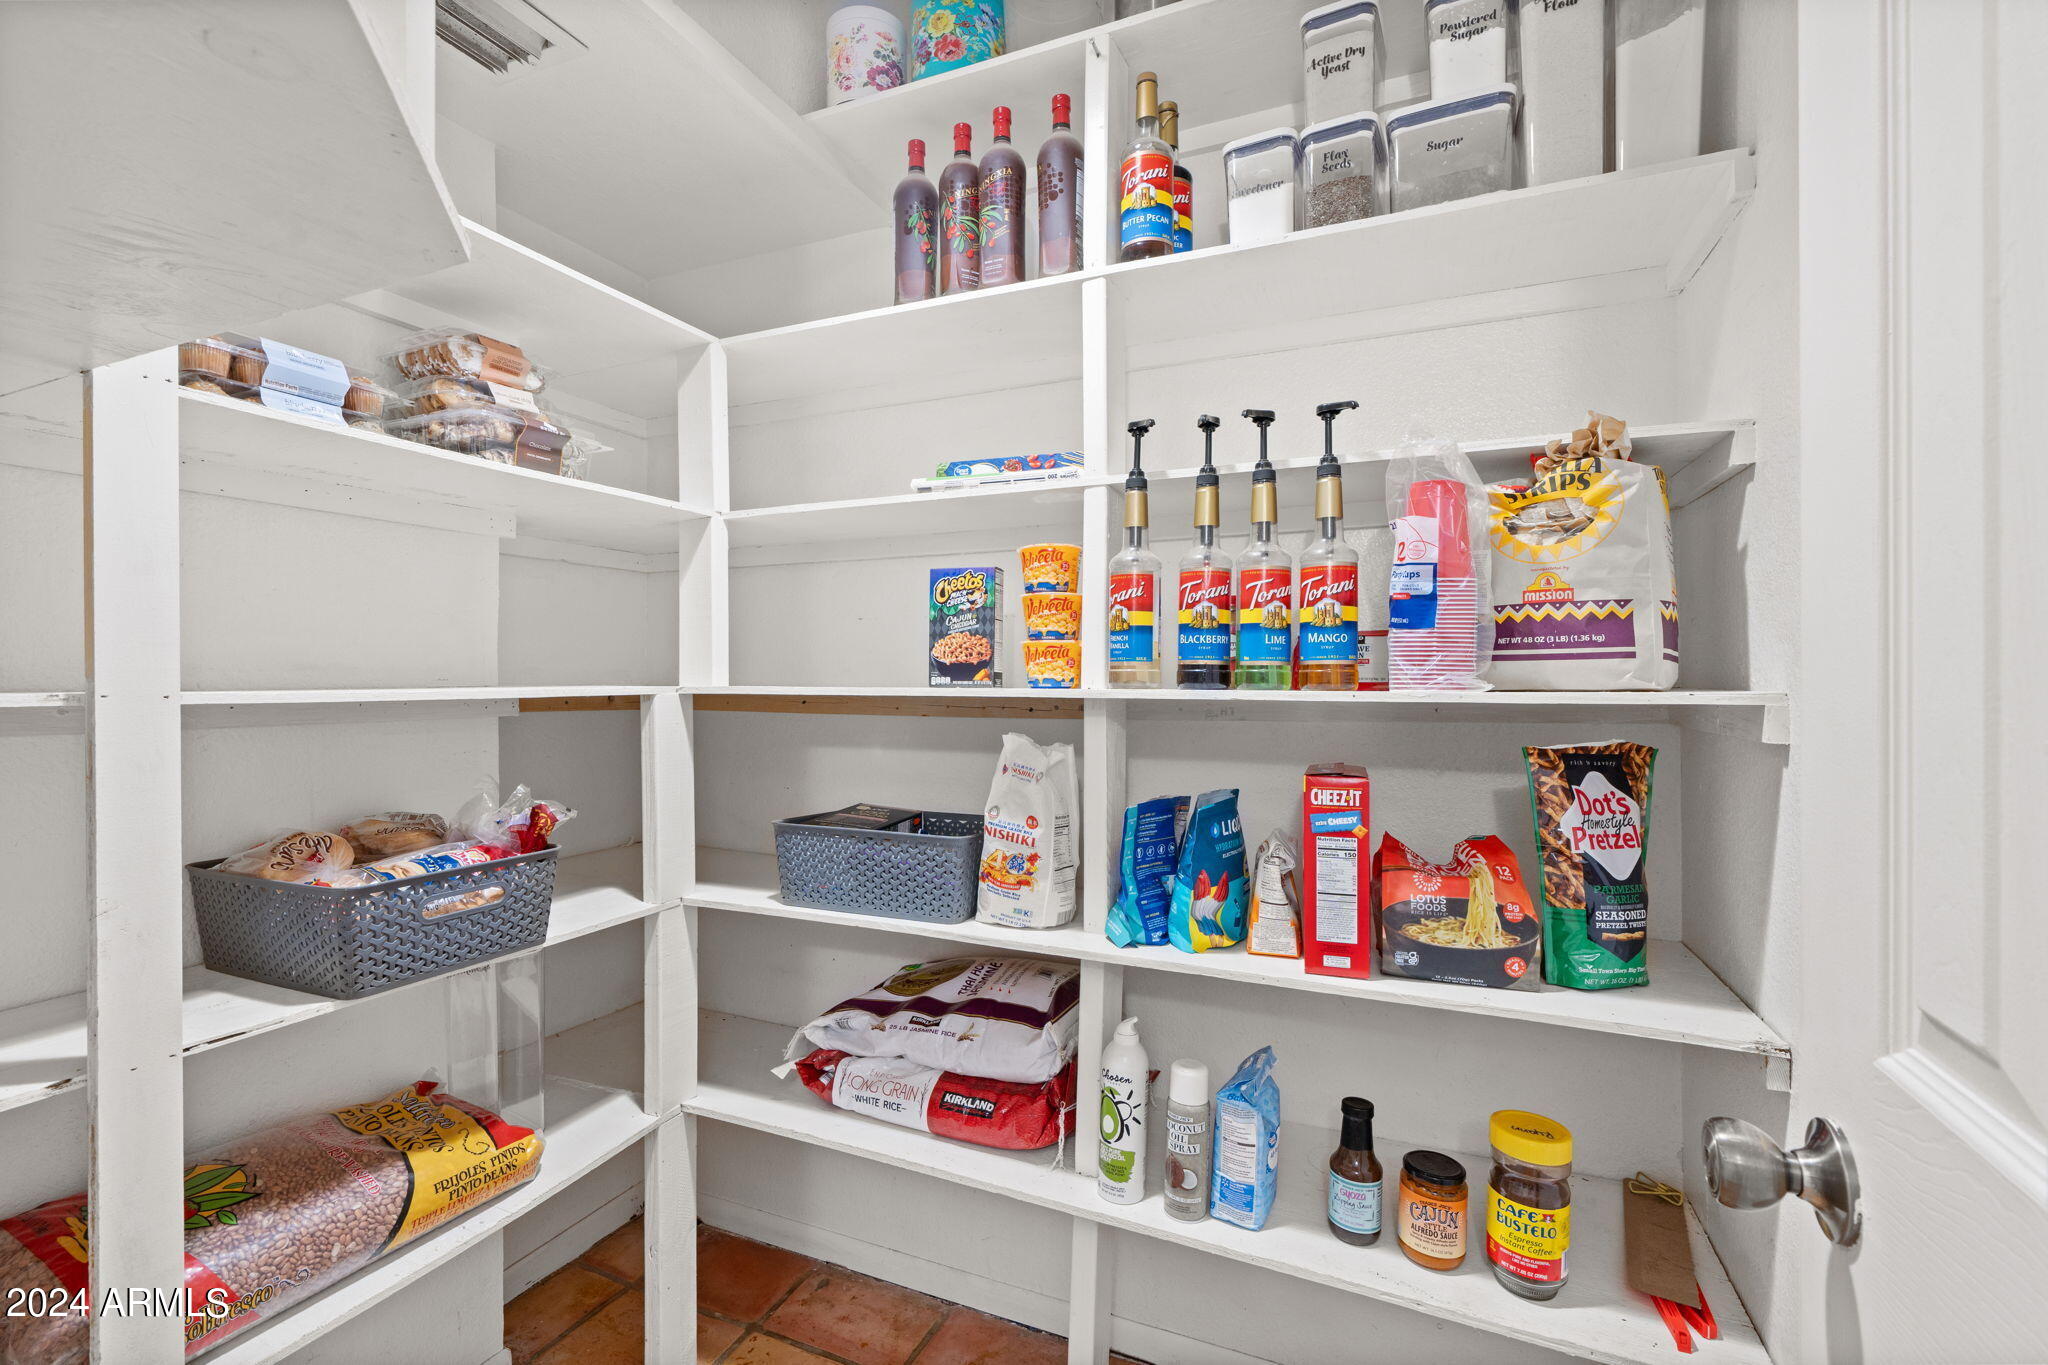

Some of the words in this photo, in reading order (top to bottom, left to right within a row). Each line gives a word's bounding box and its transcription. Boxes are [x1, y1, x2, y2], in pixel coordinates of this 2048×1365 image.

[1440, 9, 1497, 34] Powdered
[1450, 25, 1488, 42] Sugar
[1306, 51, 1343, 73] Active
[1344, 45, 1366, 61] Dry
[1320, 60, 1351, 80] Yeast
[1426, 137, 1464, 152] Sugar
[1323, 149, 1349, 163] Flax
[1321, 159, 1352, 173] Seeds
[1121, 164, 1169, 199] Torani
[935, 571, 985, 604] Cheetos
[1180, 579, 1230, 612] Torani
[1245, 577, 1292, 610] Toran
[1300, 574, 1356, 609] Torani
[1524, 588, 1574, 602] mission
[946, 613, 972, 627] CAJUN
[1180, 634, 1229, 644] BLACKBERRY
[1265, 634, 1286, 645] LIME
[1308, 633, 1348, 643] MANGO
[1523, 635, 1533, 643] 48
[1535, 635, 1545, 643] OZ
[1556, 634, 1569, 643] LB)
[1592, 633, 1606, 643] kg)
[1574, 787, 1631, 816] Dot's
[1327, 816, 1358, 826] CHEESY
[1581, 811, 1635, 835] Homestyle
[984, 824, 1036, 848] NISHIKI
[1572, 825, 1641, 851] Pretzel
[1496, 867, 1512, 876] 12
[1410, 894, 1447, 904] LOTUS
[1606, 894, 1640, 904] GARLIC
[1410, 903, 1447, 912] FOODS
[1506, 903, 1520, 913] 8g
[1595, 909, 1647, 920] SEASONED
[1511, 963, 1520, 971] 4
[958, 970, 978, 996] THAI
[909, 1026, 939, 1035] JASMINE
[940, 1029, 957, 1037] RICE
[1102, 1068, 1132, 1084] Chosen
[882, 1080, 920, 1102] GRAIN
[944, 1092, 995, 1112] KIRKLAND
[1170, 1131, 1187, 1144] OIL
[1168, 1141, 1198, 1154] SPRAY
[434, 1161, 487, 1195] FRIJOLES
[489, 1142, 527, 1168] PINTOS
[448, 1179, 482, 1202] PINTO
[484, 1158, 518, 1185] BEANS
[411, 1204, 448, 1229] TRIPLE
[1410, 1202, 1459, 1229] CAJUN
[1411, 1222, 1438, 1239] ALFREDO
[1440, 1232, 1458, 1240] SAUCE
[1424, 1223, 1448, 1232] STYLE
[1496, 1210, 1557, 1239] BUSTELO
[1500, 1234, 1525, 1250] Instant
[1527, 1246, 1553, 1256] Coffee
[1508, 1232, 1543, 1247] Espresso
